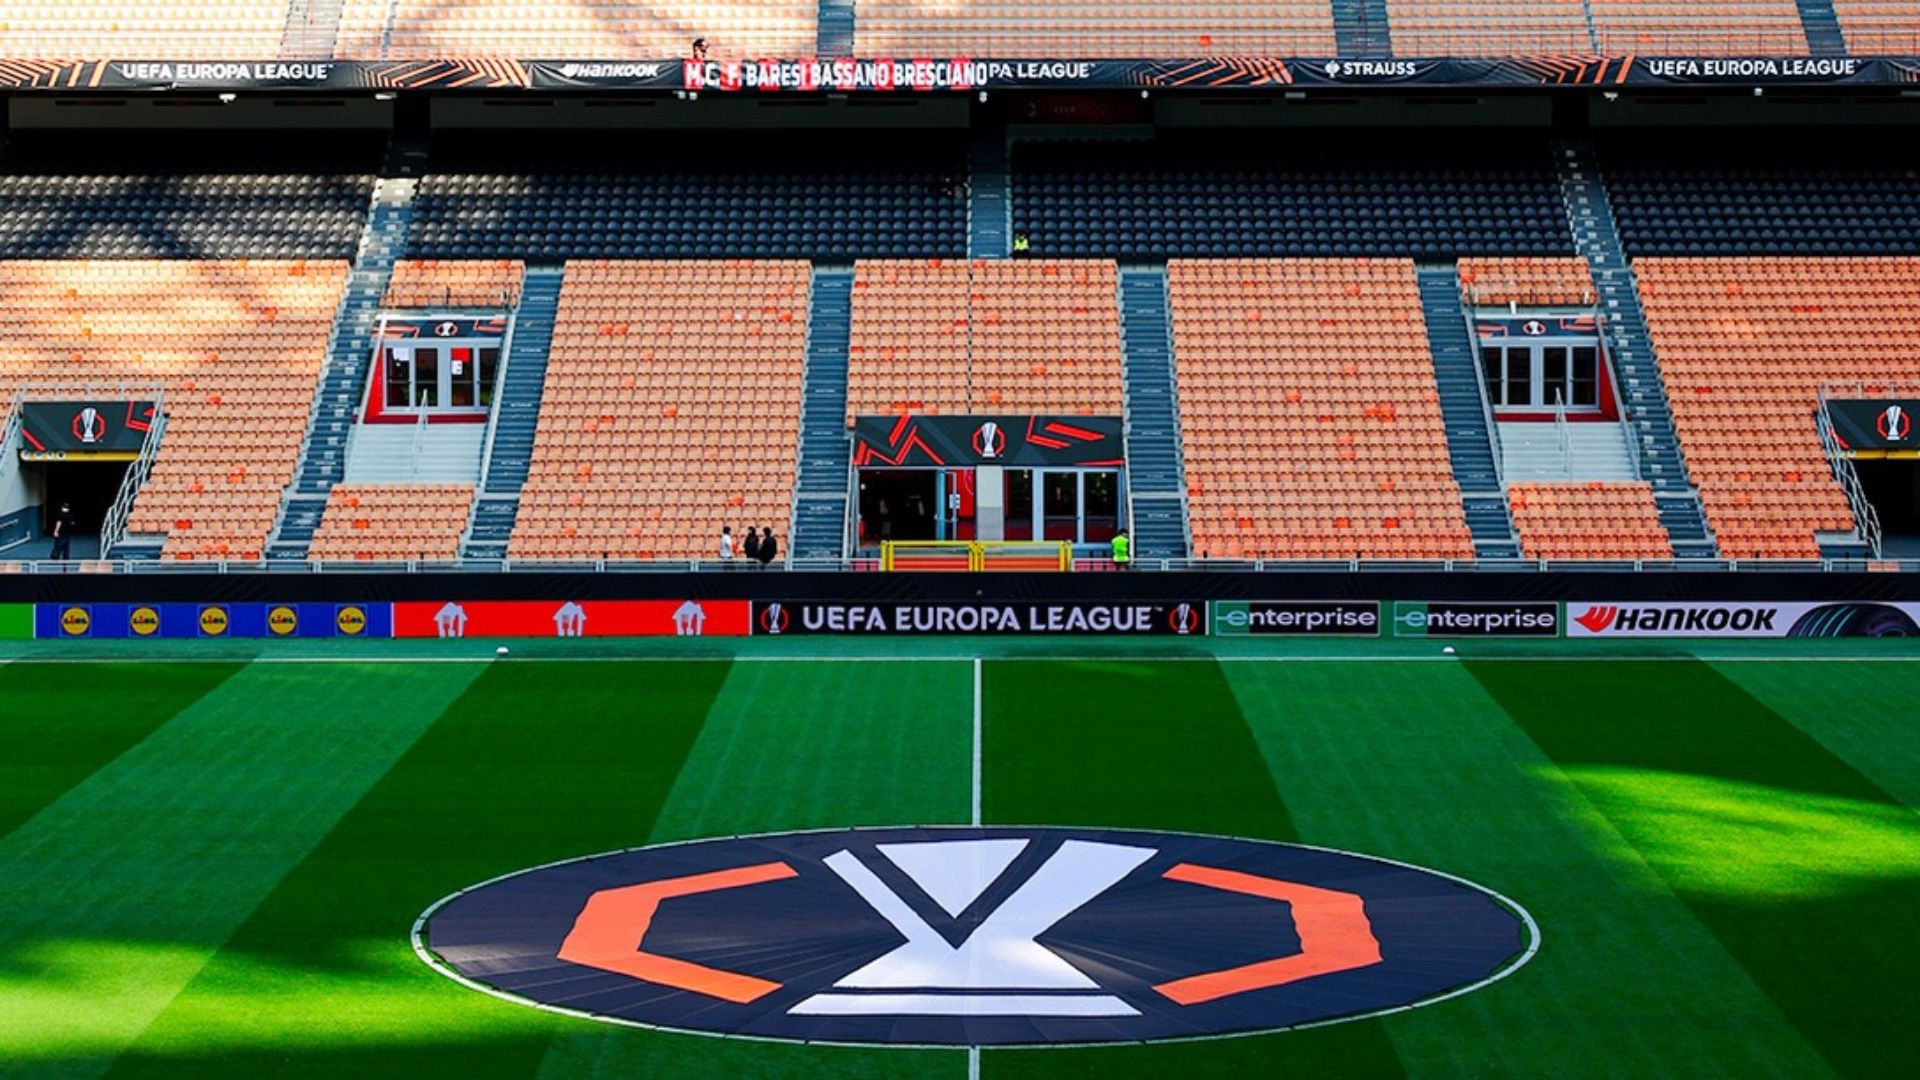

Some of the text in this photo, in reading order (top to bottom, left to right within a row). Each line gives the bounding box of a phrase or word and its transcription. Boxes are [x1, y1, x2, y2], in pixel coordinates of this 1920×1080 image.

[123, 63, 327, 79] UEFA EUROPA LEAGUE
[746, 63, 806, 86] BARESI
[811, 62, 892, 86] BASSANO
[894, 62, 987, 86] BRESCIANO
[1018, 62, 1089, 78] LEAGUE
[1343, 62, 1416, 76] STRAUSS
[1650, 60, 1855, 75] UEFA EUROPA LEAGUE
[803, 606, 1152, 631] UEFA EUROPA LEAGUE
[1225, 608, 1377, 631] enterprise
[1403, 608, 1556, 632] enterprise
